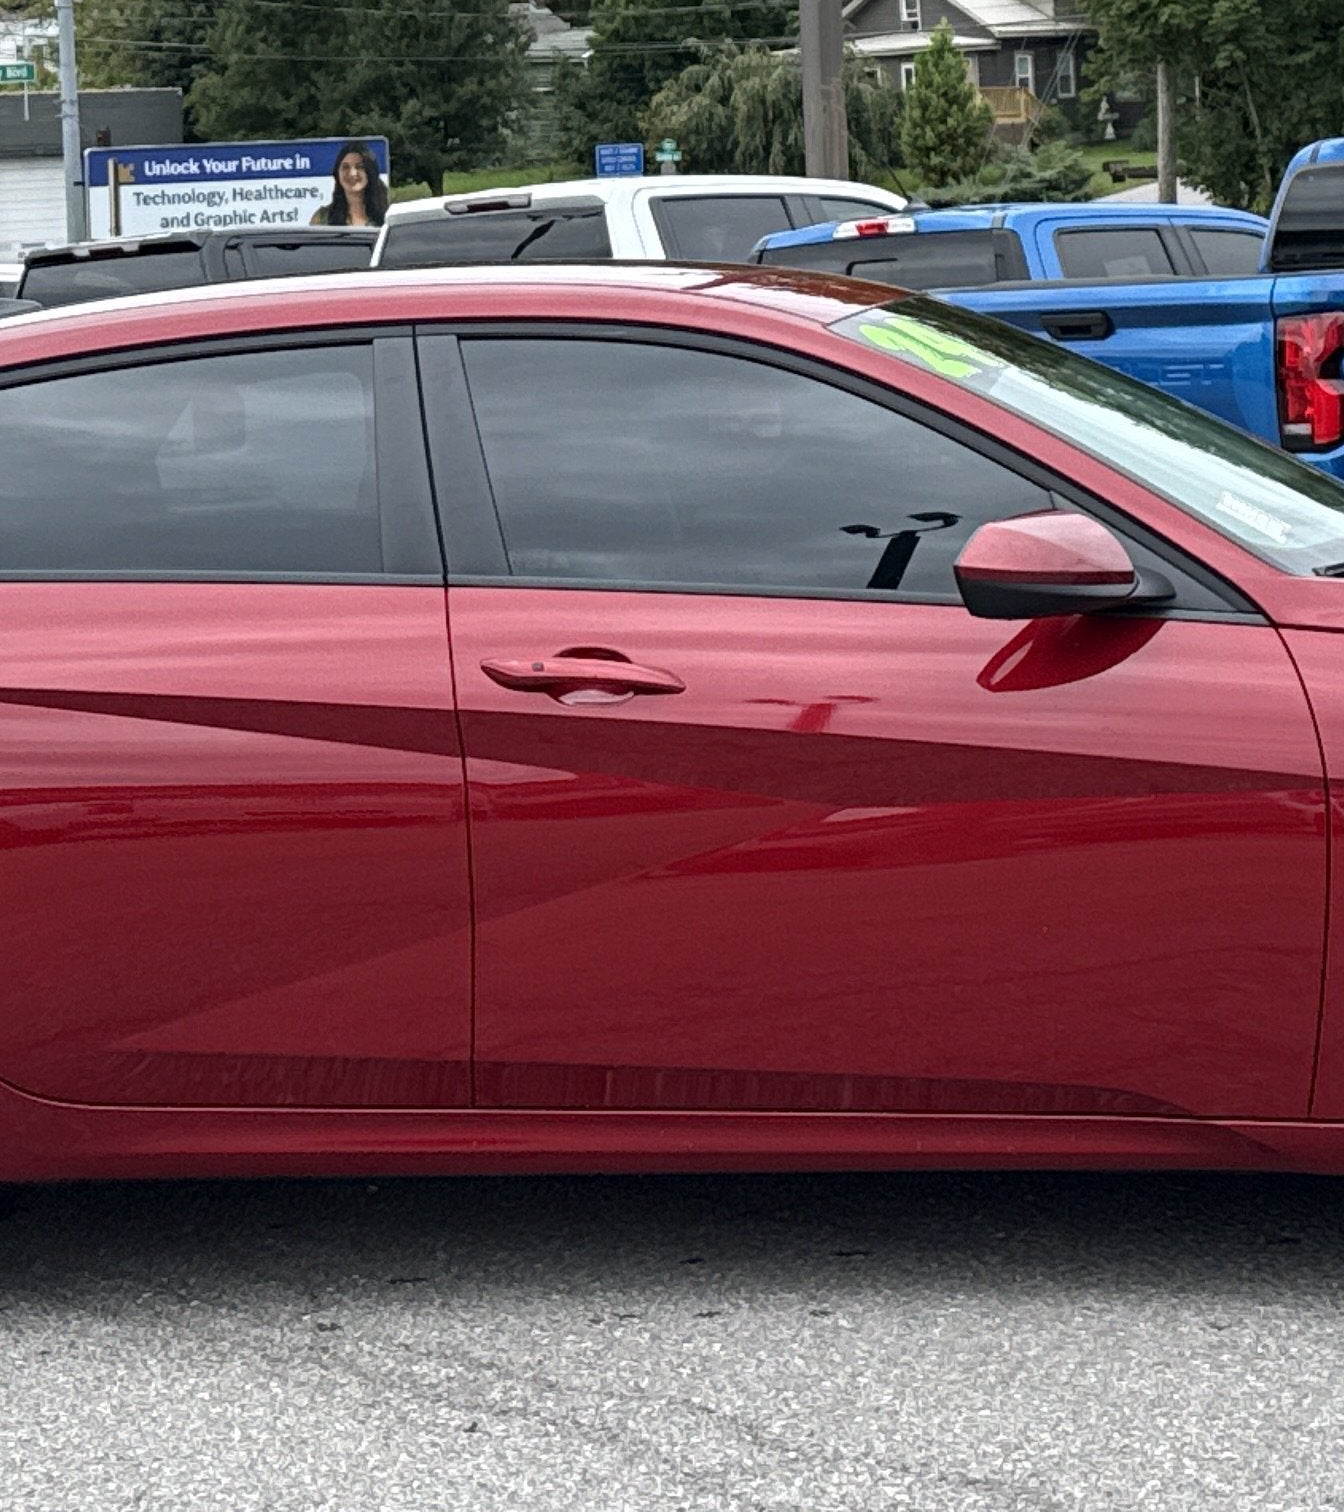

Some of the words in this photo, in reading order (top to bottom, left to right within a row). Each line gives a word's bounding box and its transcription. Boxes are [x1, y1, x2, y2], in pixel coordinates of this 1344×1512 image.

[144, 154, 200, 176] Unlock
[203, 156, 240, 175] Your
[241, 154, 293, 172] Future
[295, 153, 311, 170] in
[133, 190, 229, 207] Technology,
[232, 185, 324, 202] Healthcare,
[160, 212, 191, 228] and
[194, 209, 257, 228] Graphic
[260, 207, 299, 224] Arts!
